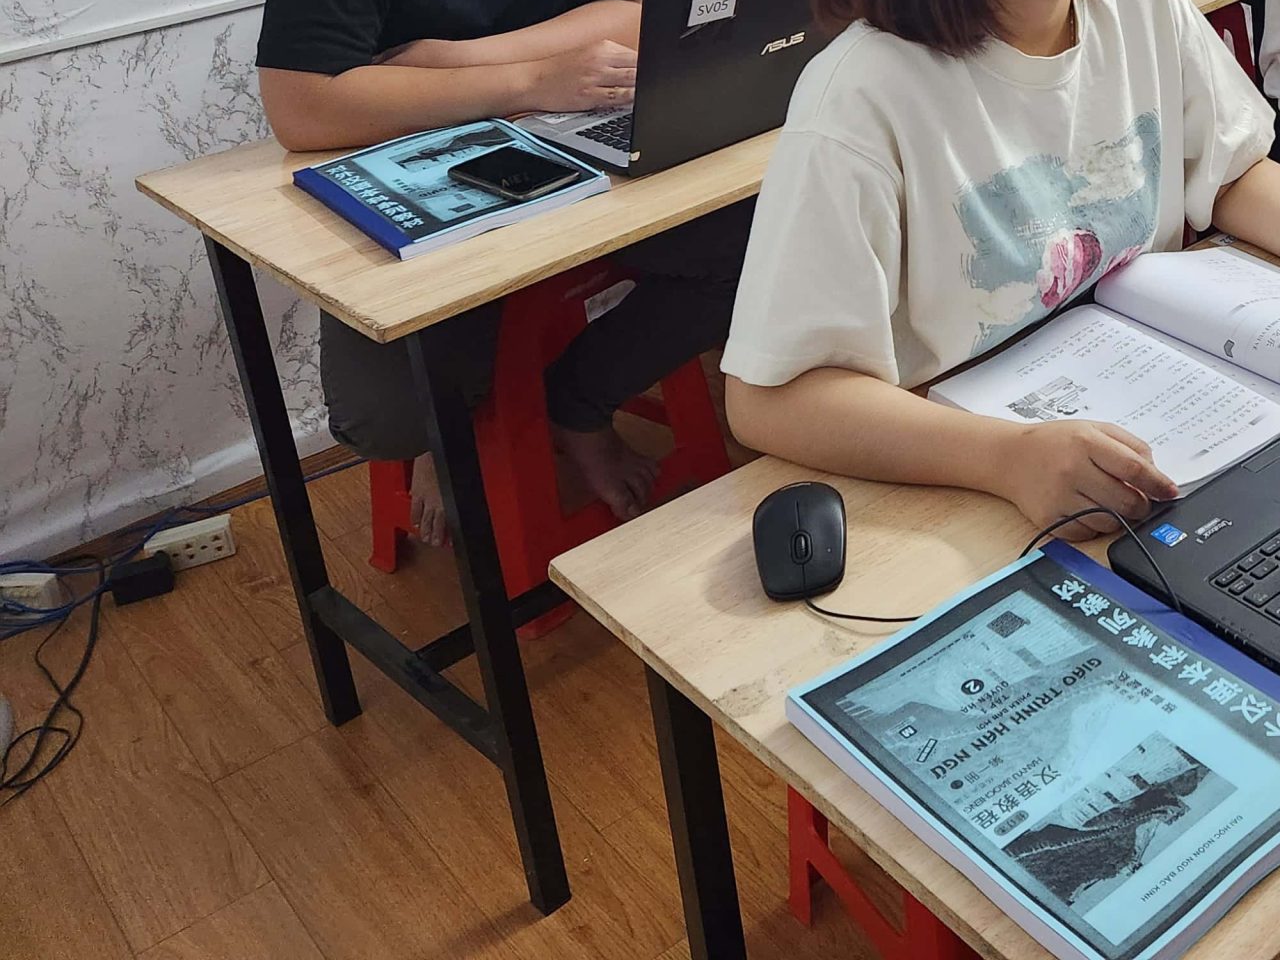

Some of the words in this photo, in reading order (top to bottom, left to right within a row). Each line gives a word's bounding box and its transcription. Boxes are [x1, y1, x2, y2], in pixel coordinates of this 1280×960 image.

[696, 0, 729, 17] SV05
[760, 32, 806, 55] ASUS
[962, 680, 982, 693] 2
[1060, 658, 1103, 688] GIÁO
[1008, 686, 1064, 725] TRÌNH
[899, 726, 915, 737] M
[969, 721, 1011, 751] HÁN
[928, 748, 971, 780] NGỮ
[1010, 756, 1043, 780] HANYU
[961, 776, 1013, 814] JIAOCHENG
[970, 764, 1062, 830] 汉语教程
[1139, 884, 1160, 902] KINH
